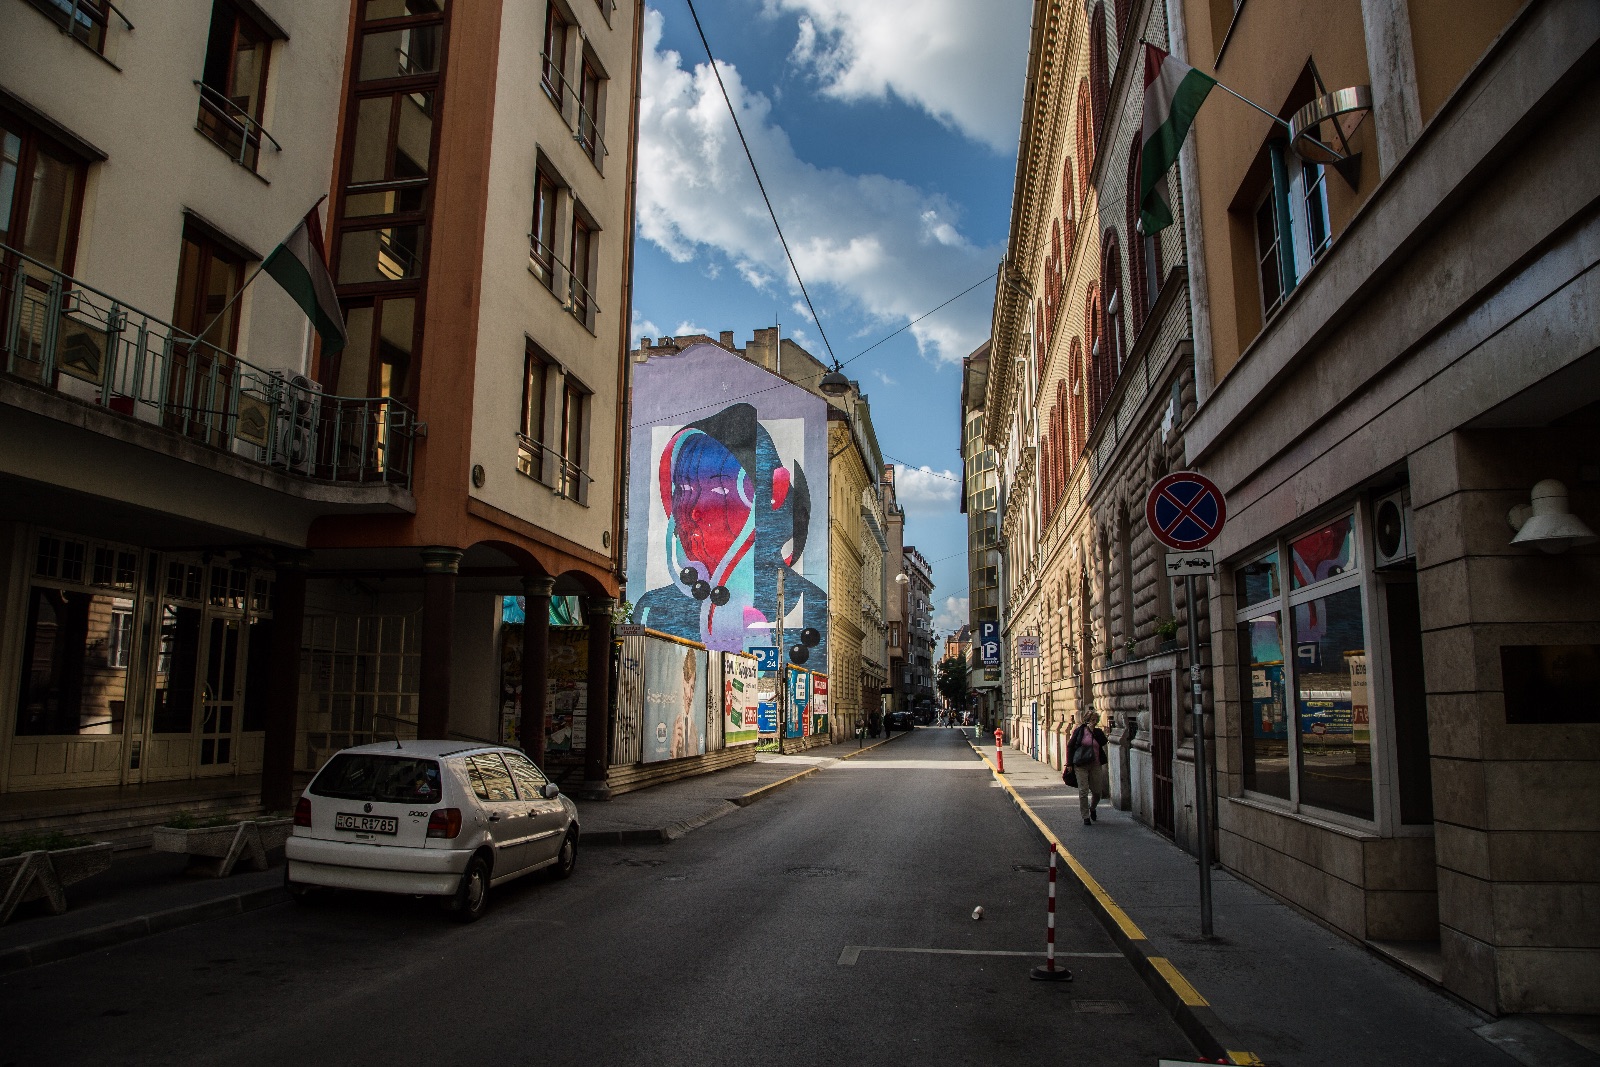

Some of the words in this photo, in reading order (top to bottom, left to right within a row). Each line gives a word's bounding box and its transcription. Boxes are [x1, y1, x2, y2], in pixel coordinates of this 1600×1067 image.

[984, 623, 994, 637] P
[752, 649, 766, 662] P
[769, 649, 775, 657] 0
[986, 644, 998, 658] P
[766, 660, 777, 668] 24
